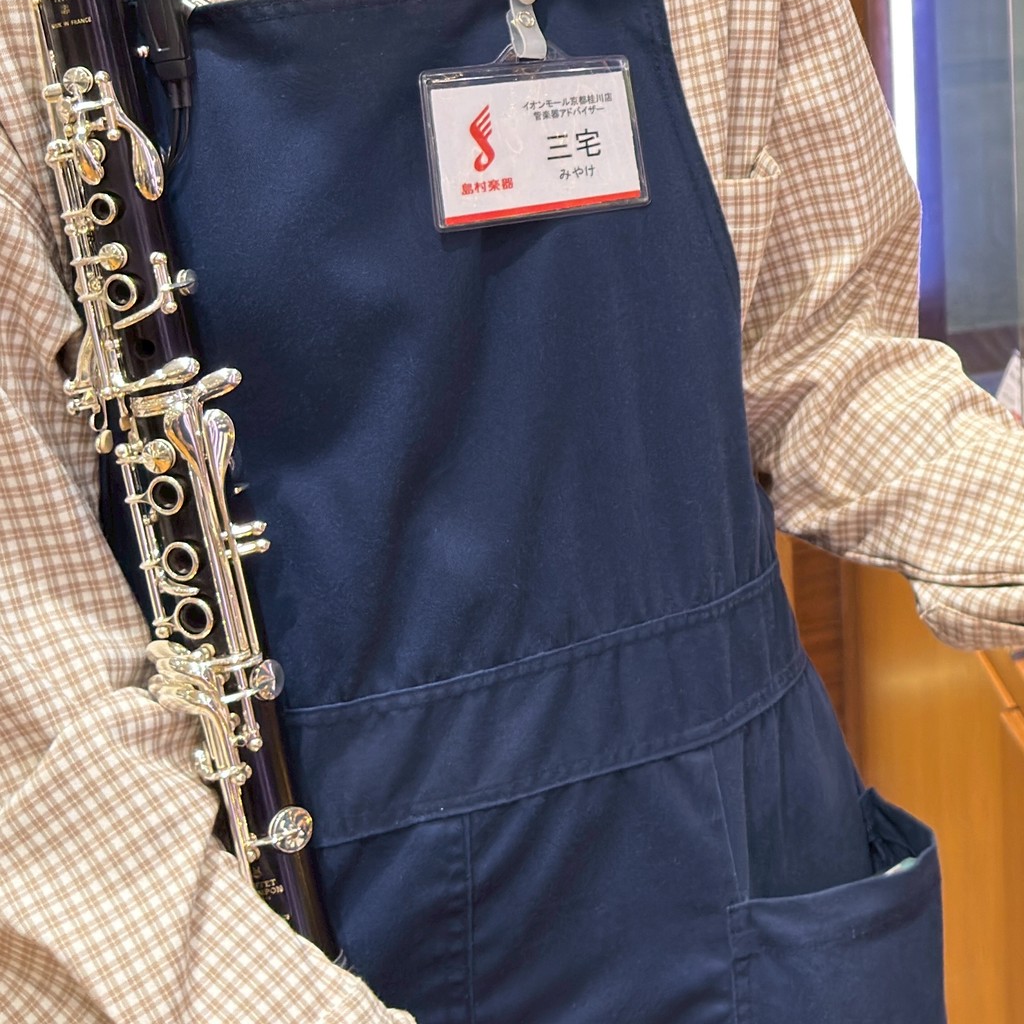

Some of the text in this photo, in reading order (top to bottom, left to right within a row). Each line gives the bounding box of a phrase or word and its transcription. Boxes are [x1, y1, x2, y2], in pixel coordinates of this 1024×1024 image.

[522, 92, 613, 111] イオンモール京都桂川店
[533, 105, 605, 121] 管楽器アドバイザー
[547, 128, 602, 161] 三宅
[559, 164, 596, 180] みやけ
[461, 177, 514, 196] 島村楽器
